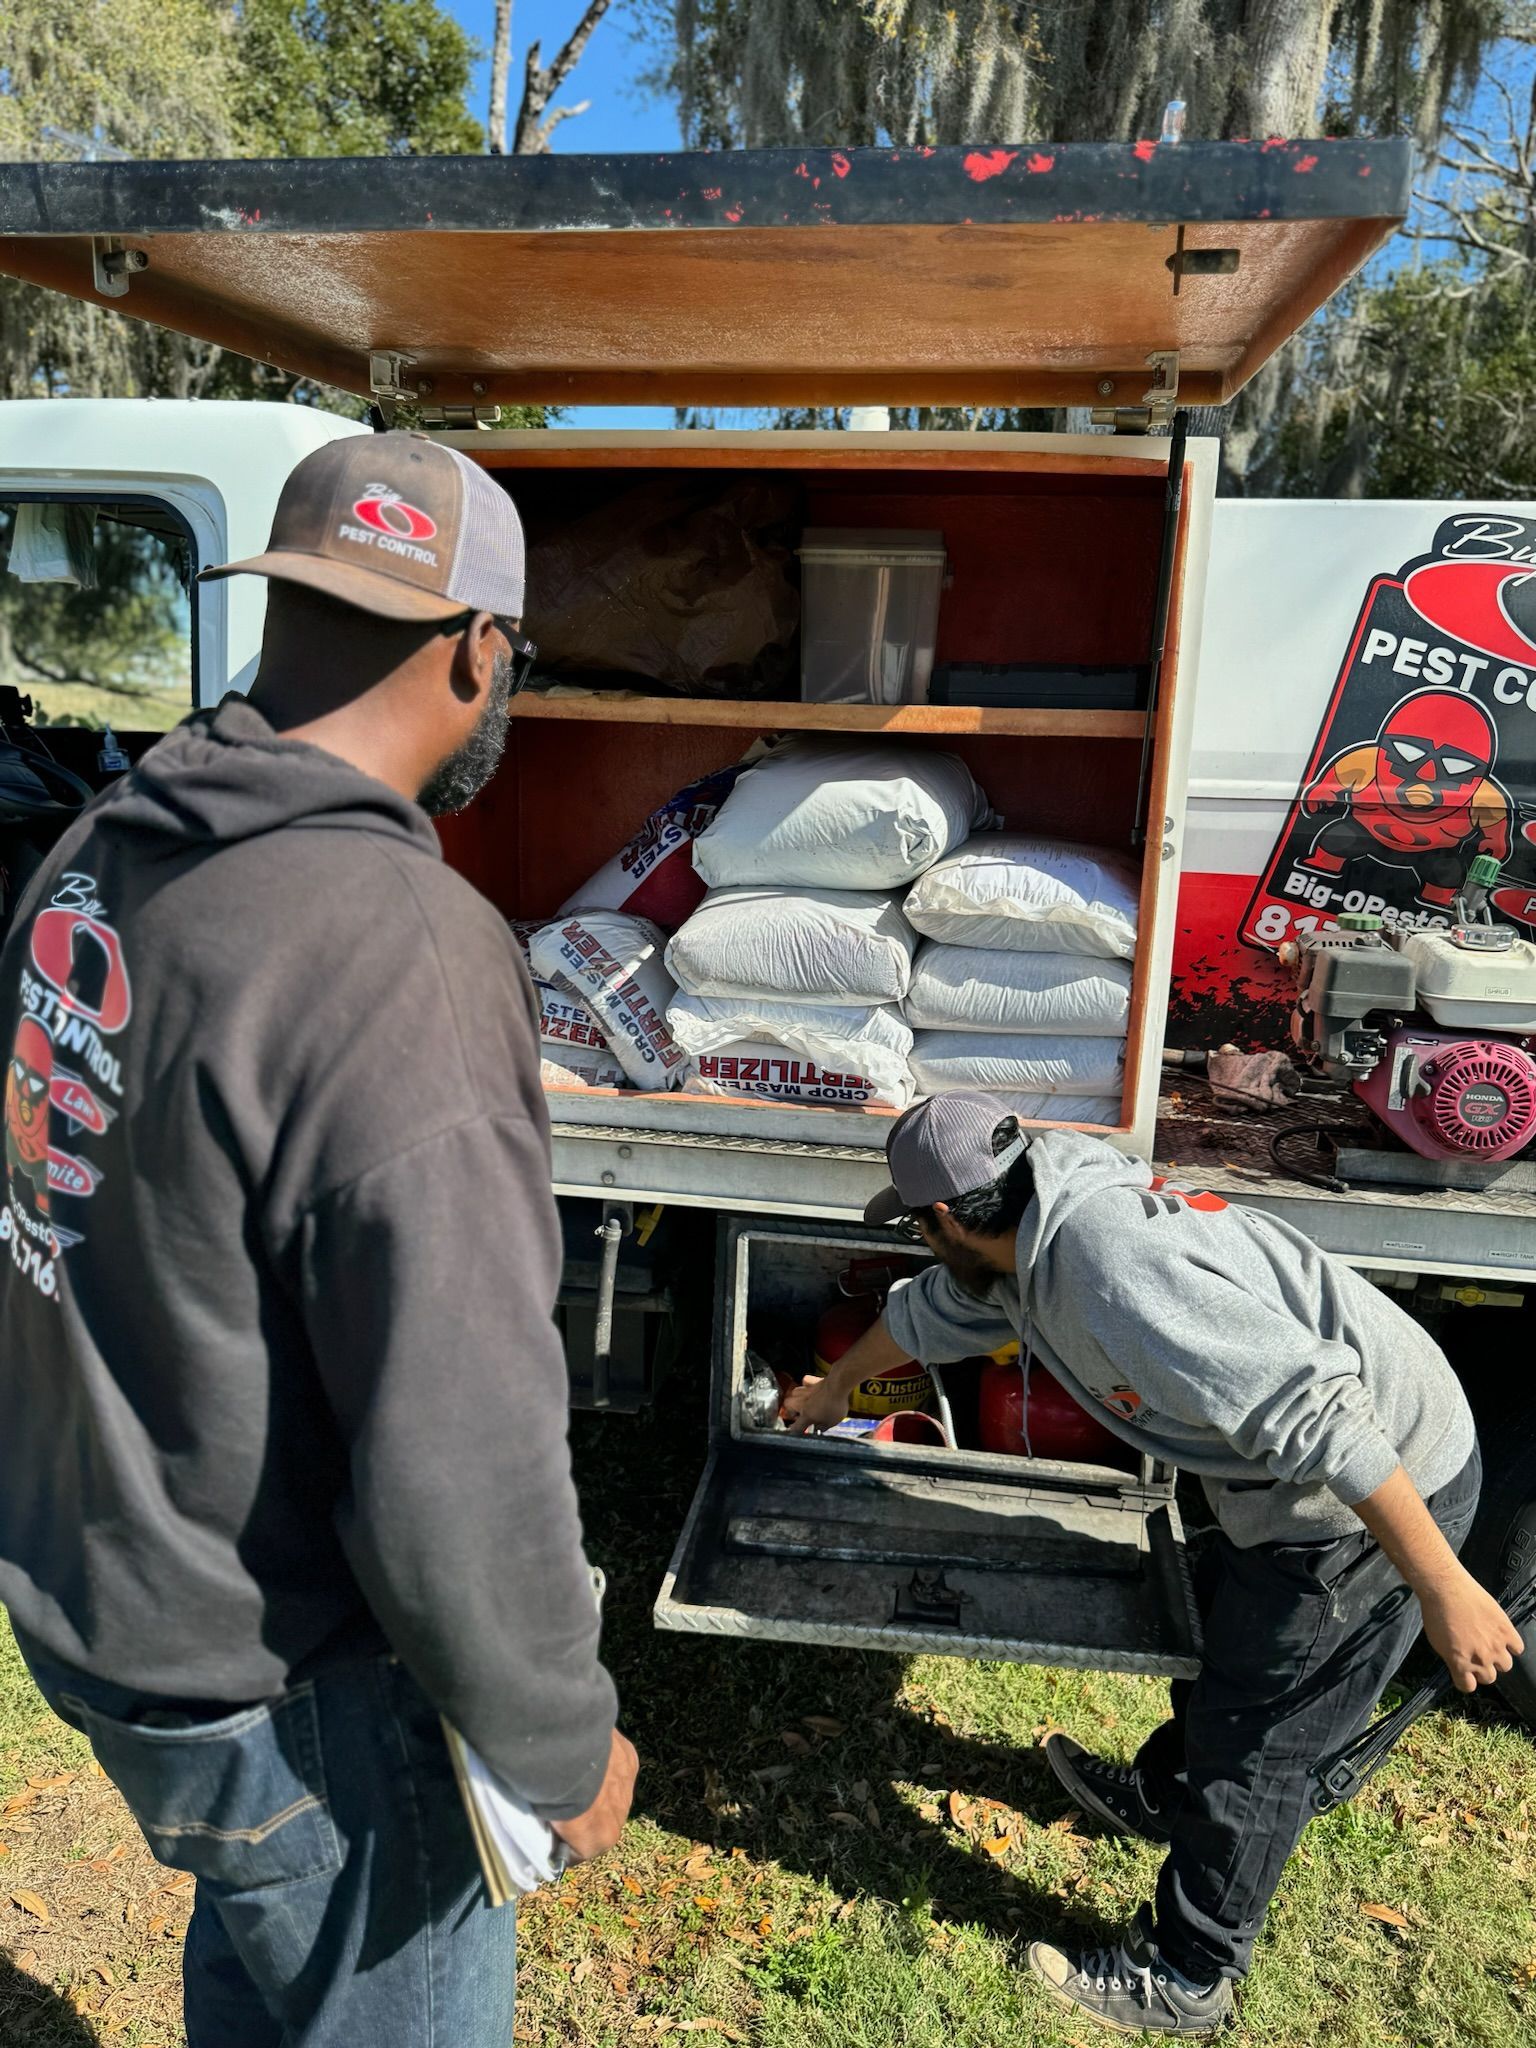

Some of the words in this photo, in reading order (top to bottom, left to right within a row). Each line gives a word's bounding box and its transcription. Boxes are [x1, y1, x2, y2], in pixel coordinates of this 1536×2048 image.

[362, 483, 402, 507] Big
[339, 525, 376, 545] PEST
[377, 536, 438, 567] CONTROL
[1361, 628, 1489, 692] PEST
[618, 1011, 656, 1063] CROP
[808, 1087, 869, 1101] CROP
[1465, 1093, 1504, 1103] HONDA
[1464, 1102, 1502, 1116] GX
